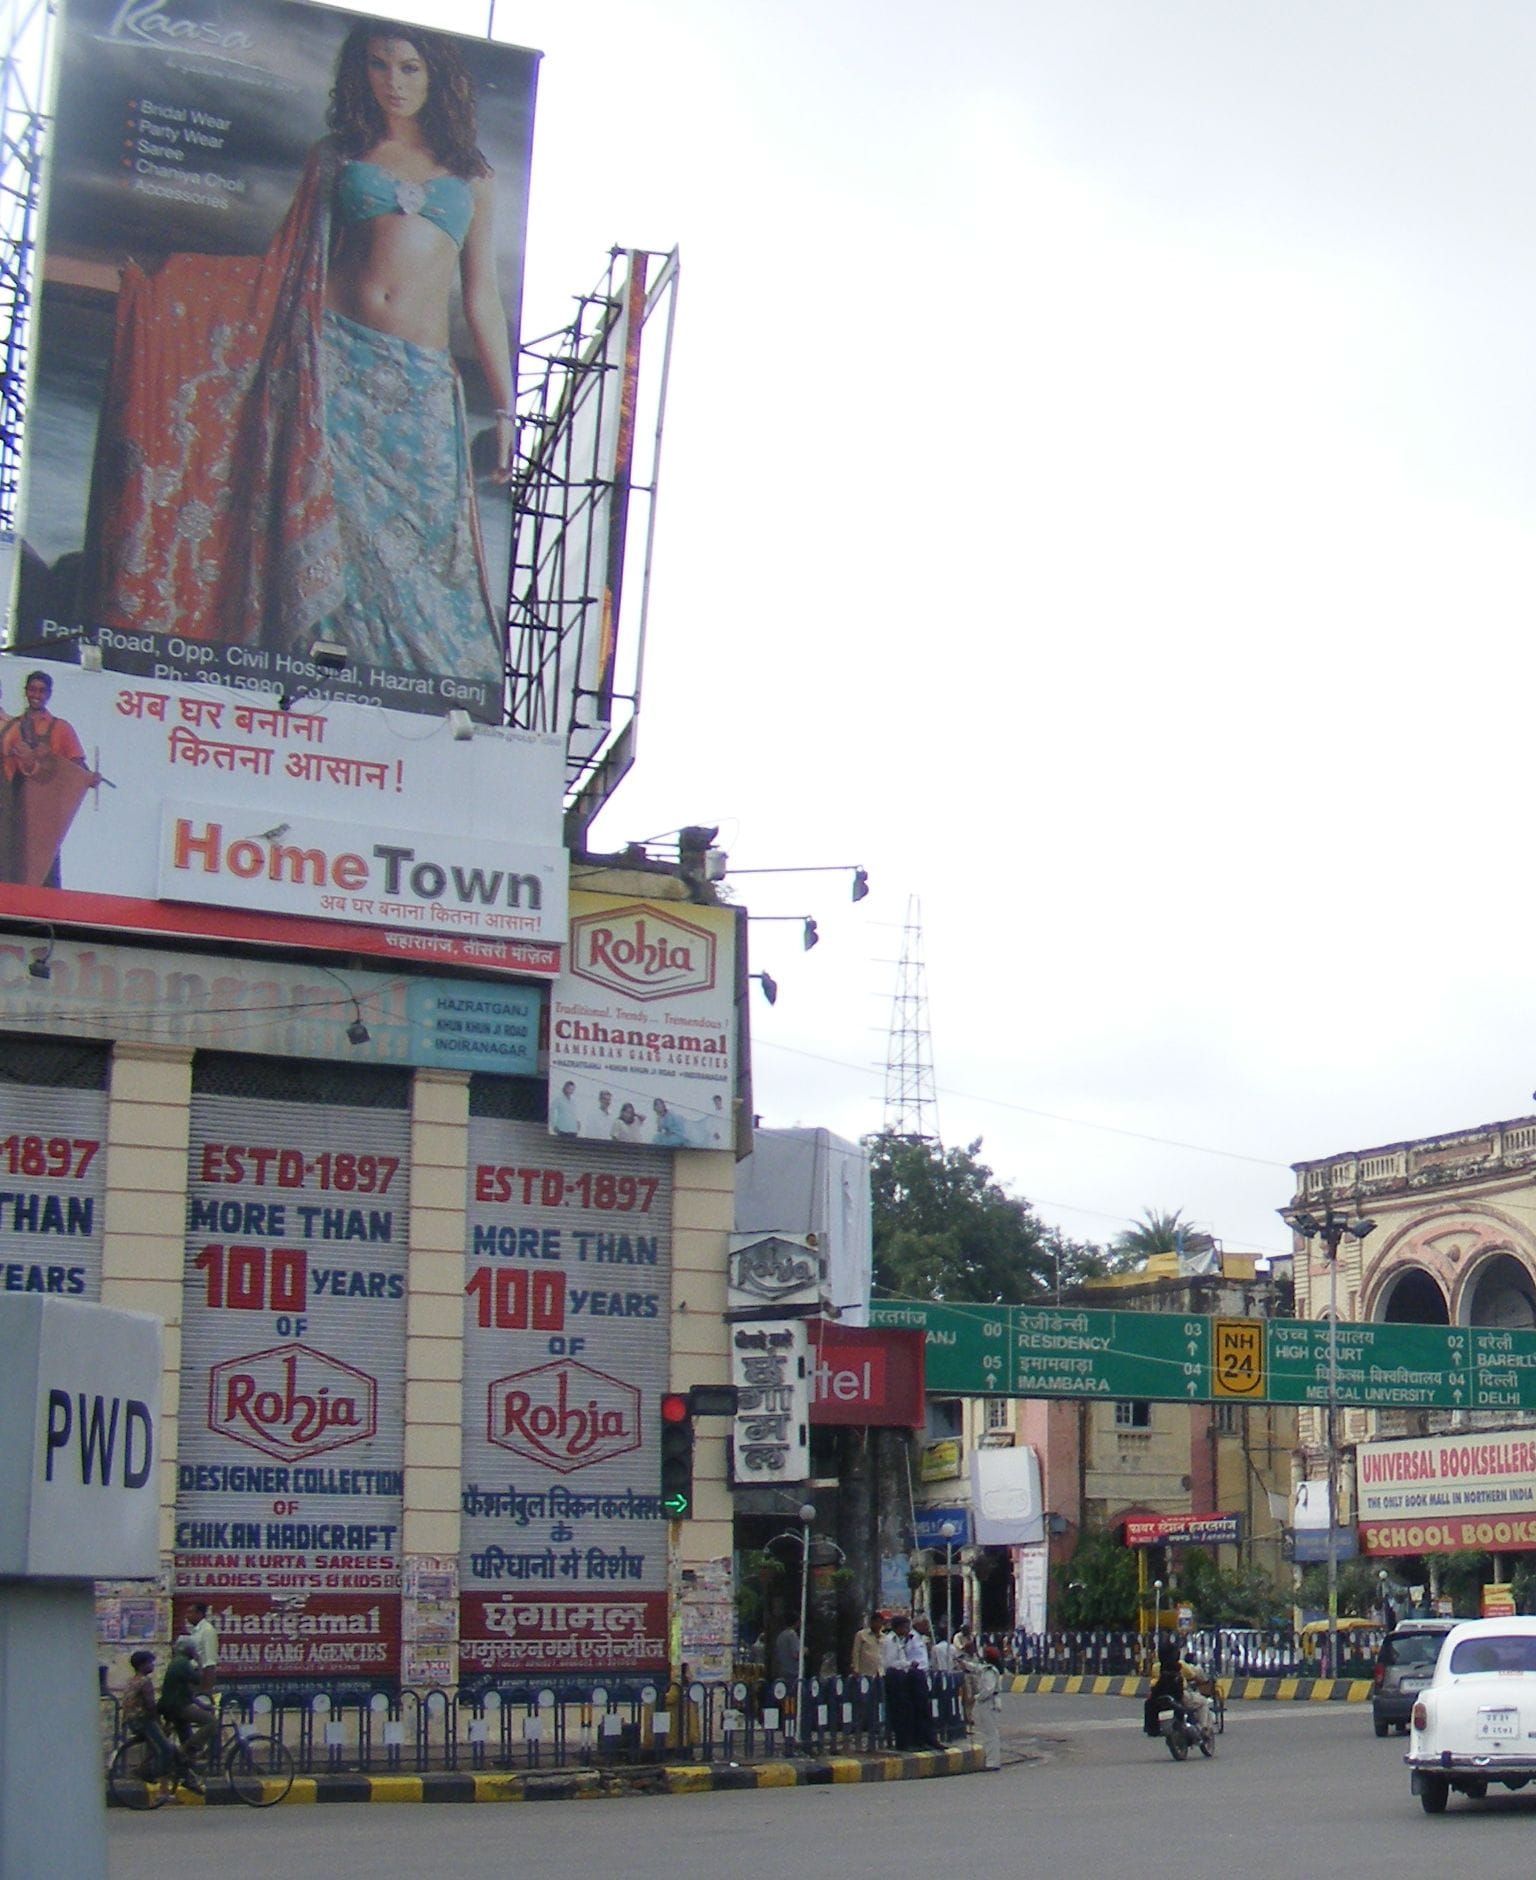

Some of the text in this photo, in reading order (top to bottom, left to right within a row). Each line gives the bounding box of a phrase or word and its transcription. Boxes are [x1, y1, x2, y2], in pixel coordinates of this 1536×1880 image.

[140, 100, 232, 131] Bridal Wear
[138, 118, 225, 149] Party Wear
[137, 139, 185, 162] Saree
[133, 178, 230, 211] Accessories
[98, 627, 161, 659] Road,
[167, 638, 219, 665] Opp.
[226, 645, 270, 671] Civil
[369, 667, 434, 697] Hazrat
[439, 679, 487, 706] Ganj
[115, 690, 328, 744] अब घर बनाना
[168, 725, 275, 776] कितना
[320, 894, 542, 933] अब घर बनाना कितना आसान!
[436, 999, 529, 1017] HAZRATGANJ
[555, 1018, 728, 1055] Chhangamal
[668, 1053, 729, 1070] AGENCIES
[190, 1199, 393, 1243] MORE THAN
[473, 1224, 658, 1266] MORE THAN
[0, 1263, 86, 1295] EARS
[194, 1243, 404, 1312] 100 YEARS
[464, 1266, 660, 1331] 100 YEARS
[276, 1316, 309, 1338] OF
[982, 1322, 1002, 1338] 00
[1184, 1321, 1202, 1337] 03
[1275, 1327, 1465, 1348] उच्च 02
[548, 1336, 586, 1356] OF
[1018, 1334, 1112, 1351] RESIDENCY
[1476, 1332, 1513, 1350] बरेली
[982, 1355, 1002, 1370] 05
[1223, 1333, 1254, 1380] NH 24
[1275, 1346, 1364, 1362] HIGH COURT
[1183, 1362, 1202, 1377] 04
[1448, 1373, 1465, 1386] 04
[1478, 1368, 1519, 1388] दिल्ली
[1018, 1376, 1111, 1393] IMAMBARA
[1306, 1385, 1436, 1402] MEDCAL UNIVERSITY
[1478, 1390, 1520, 1405] DELHI
[45, 1387, 154, 1489] PWD
[1362, 1441, 1536, 1484] UNIVERSAL BOOKSELLERS
[179, 1464, 404, 1497] DESIGNER COLLECTION
[273, 1500, 299, 1516] OF
[1367, 1487, 1534, 1509] THE ONLY BOOK MALL IN NORTHERN INDIA
[177, 1522, 398, 1551] CHIKAN HADICRAFT
[550, 1520, 574, 1542] के
[1366, 1525, 1455, 1549] SCHOOL
[174, 1552, 240, 1570] CHIKAN
[245, 1554, 307, 1569] KURTA
[194, 1572, 263, 1588] LADIES
[267, 1573, 322, 1588] SUITS
[342, 1573, 382, 1589] KIDS
[264, 1642, 388, 1663] GARG AGENCIES
